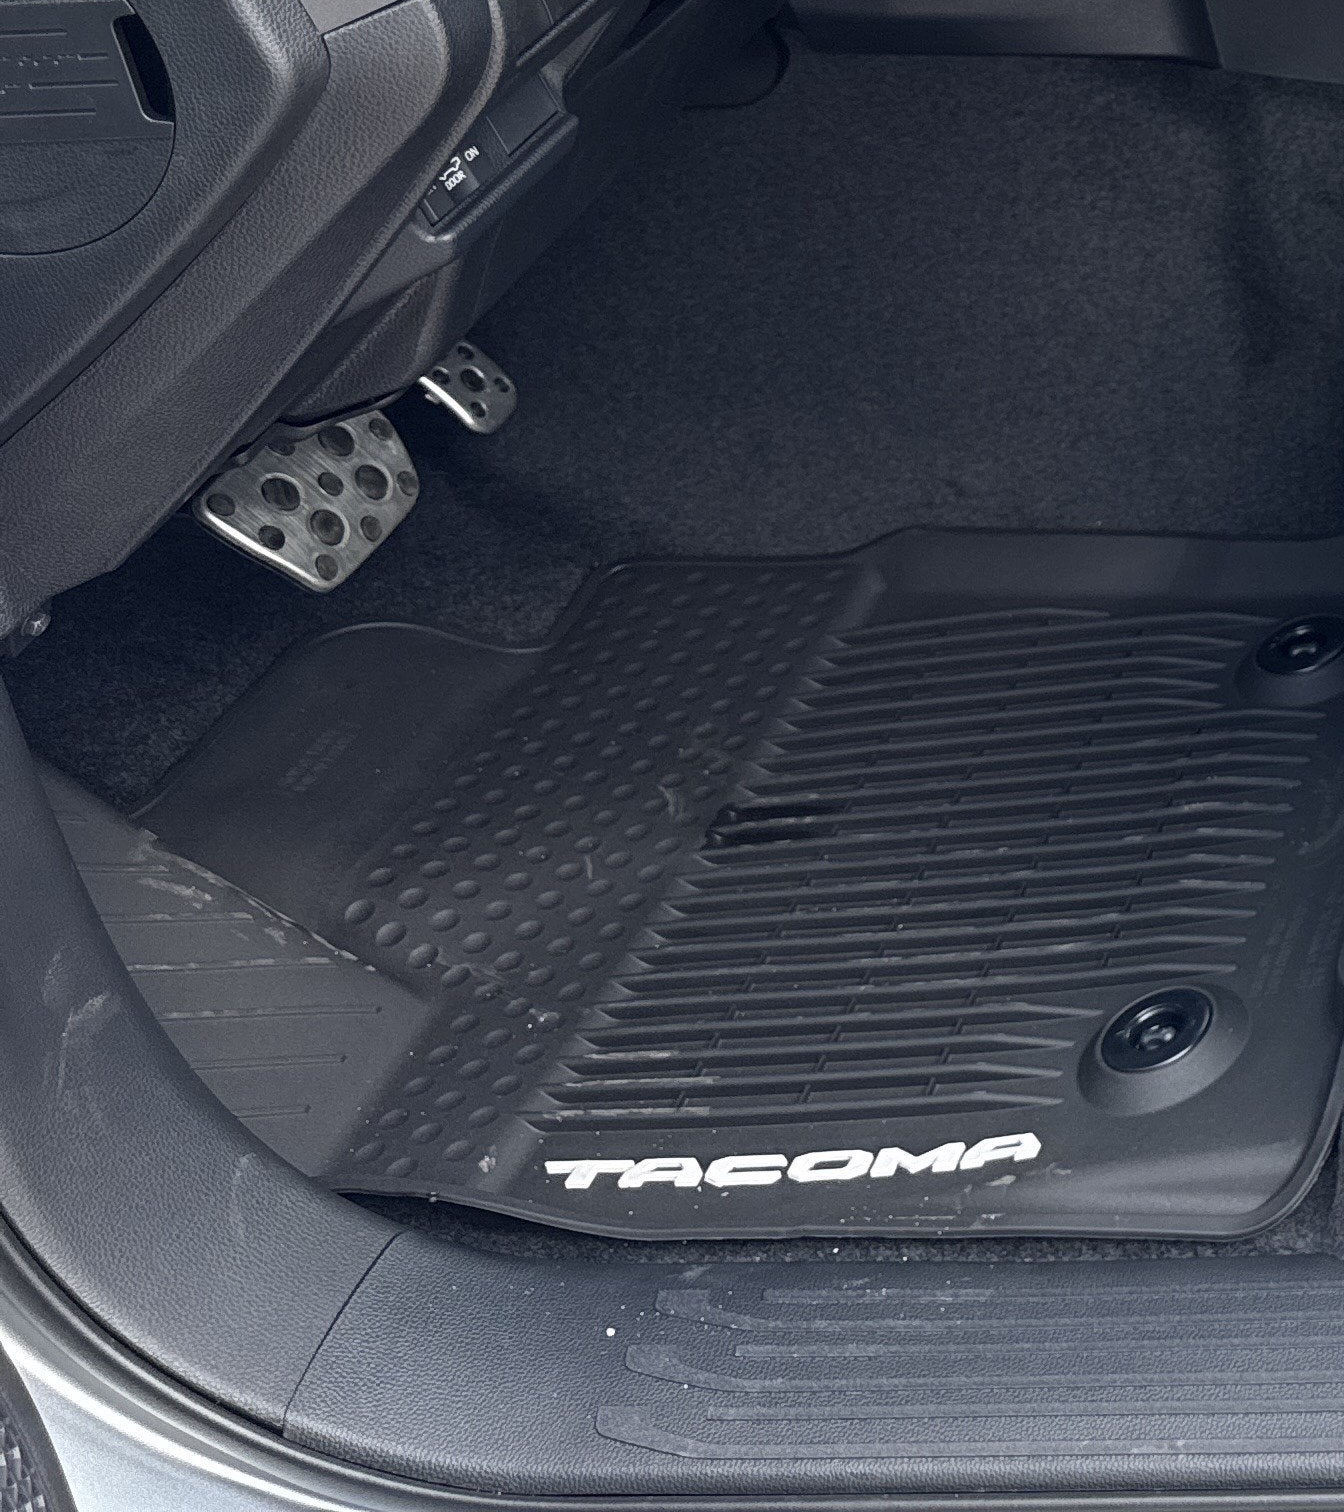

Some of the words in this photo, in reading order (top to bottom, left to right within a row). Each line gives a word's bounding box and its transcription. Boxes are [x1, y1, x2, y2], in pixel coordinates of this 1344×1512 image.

[464, 145, 480, 162] ON
[444, 170, 467, 191] DOOR
[543, 1131, 1042, 1189] TACOMA
